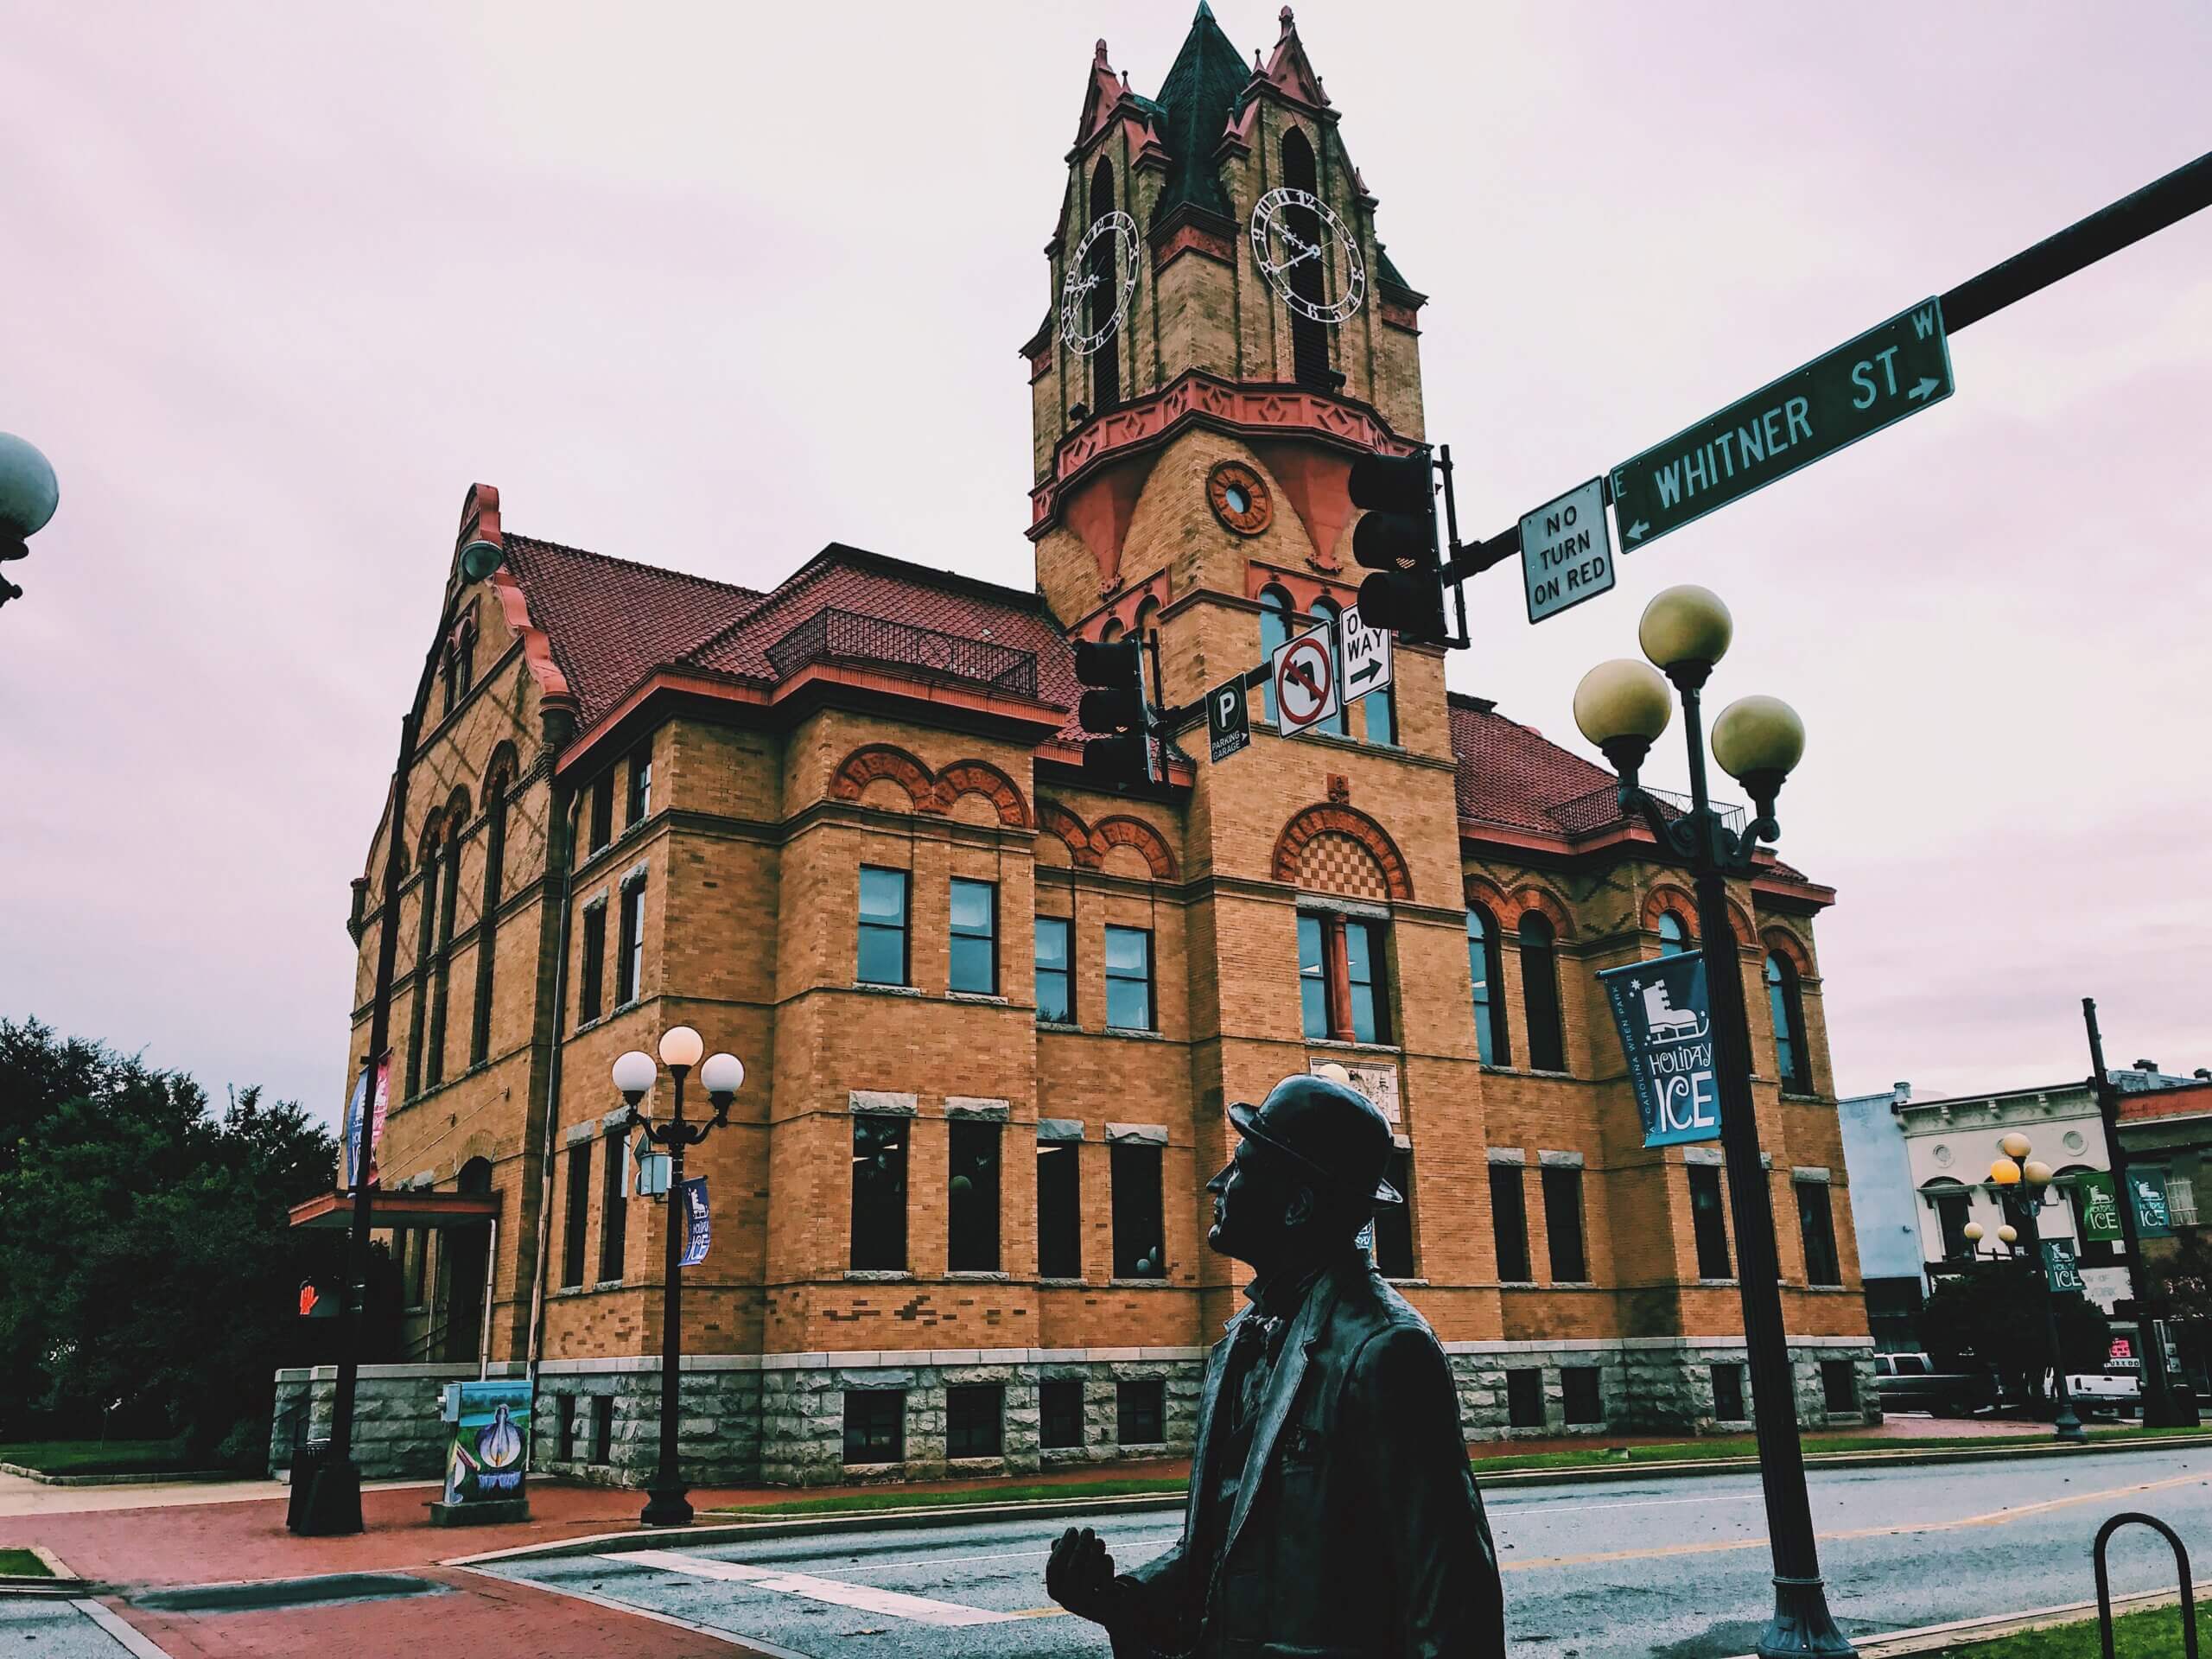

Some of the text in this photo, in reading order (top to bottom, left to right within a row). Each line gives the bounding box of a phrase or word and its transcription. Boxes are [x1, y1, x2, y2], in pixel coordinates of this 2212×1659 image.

[1255, 199, 1274, 219] 10
[1273, 188, 1291, 205] 11
[1297, 191, 1316, 210] 12
[1307, 304, 1318, 320] 6
[1330, 307, 1343, 321] 5
[1911, 307, 1935, 341] W
[1654, 345, 1899, 510] WHITNER ST
[1613, 469, 1627, 498] E
[1546, 505, 1578, 537] NO
[1540, 529, 1591, 570] TURN
[1534, 556, 1605, 606] ON RED
[1347, 628, 1382, 662] WAY
[1219, 691, 1236, 728] P
[1212, 730, 1240, 751] PARKING
[1212, 740, 1241, 760] GARAGE
[1611, 986, 1624, 1015] PARK
[1621, 1020, 1636, 1052] WREN
[1649, 1043, 1713, 1076] HOLIDAY
[1632, 1057, 1652, 1115] CAROLINA
[1654, 1071, 1715, 1133] ICE
[2090, 1212, 2118, 1230] ICE
[2139, 1210, 2165, 1227] ICE
[688, 1233, 710, 1261] ICE
[2055, 1270, 2082, 1287] ICE
